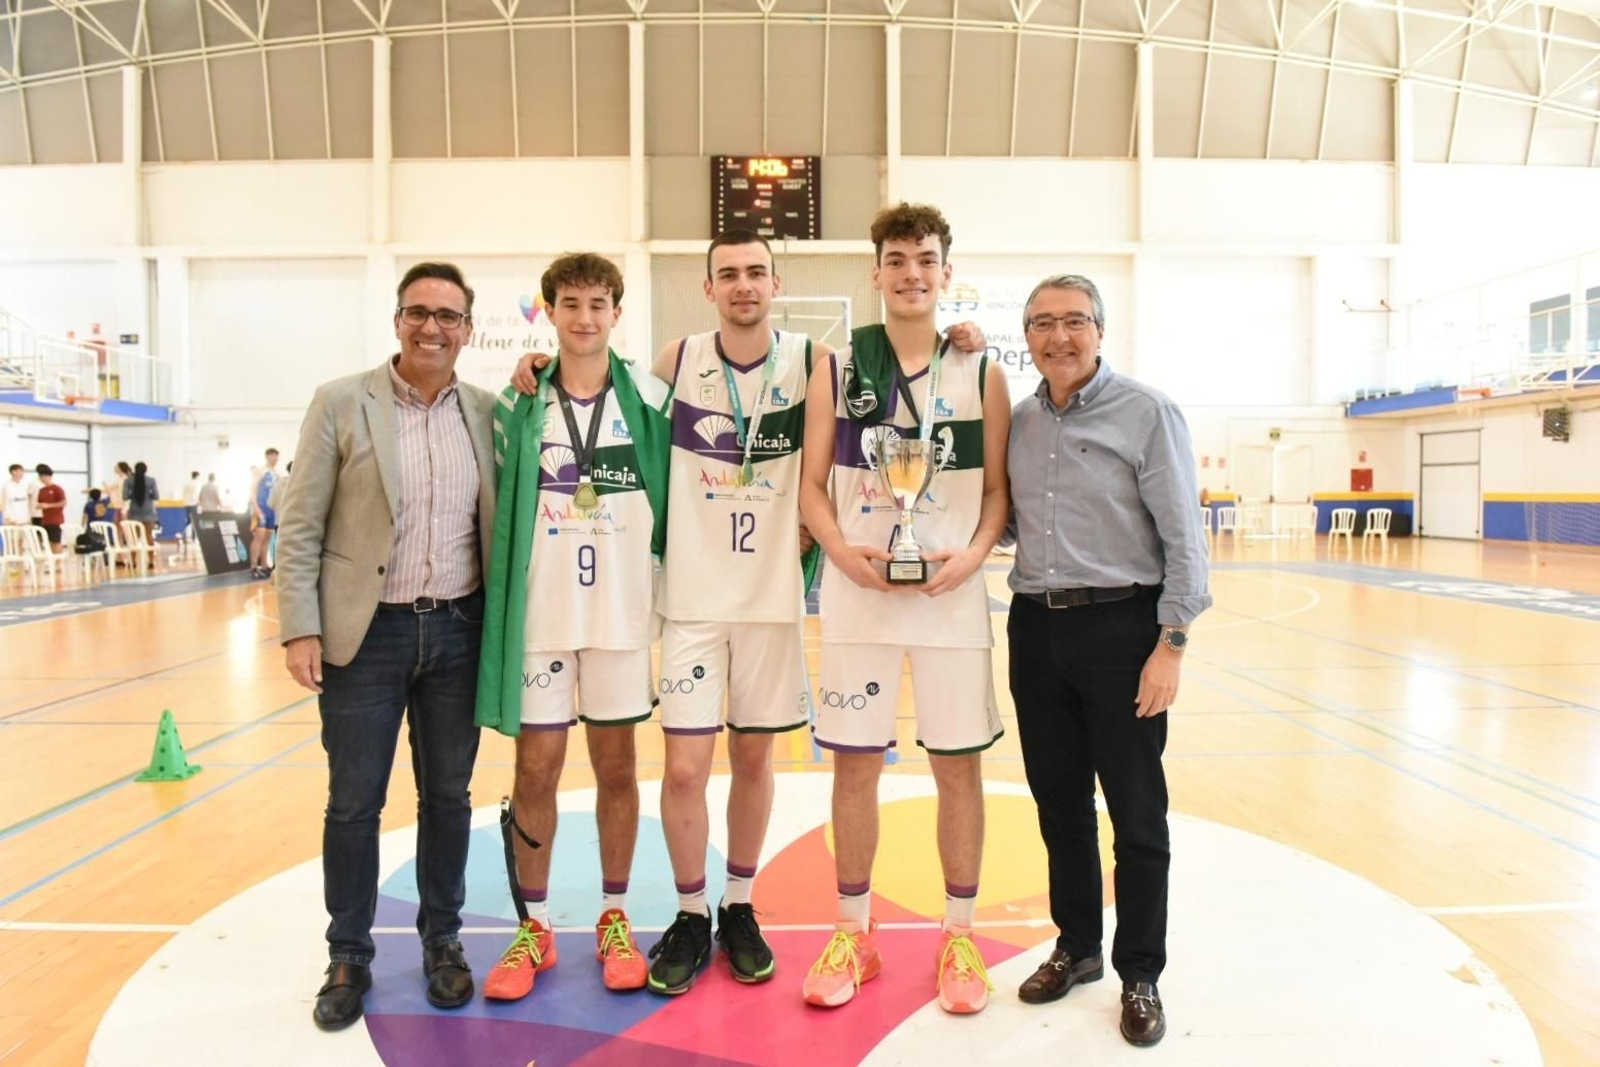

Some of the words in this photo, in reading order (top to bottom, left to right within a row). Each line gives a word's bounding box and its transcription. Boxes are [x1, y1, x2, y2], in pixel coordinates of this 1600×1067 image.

[591, 464, 636, 485] nicaja
[730, 512, 755, 553] 12
[578, 544, 596, 587] 9
